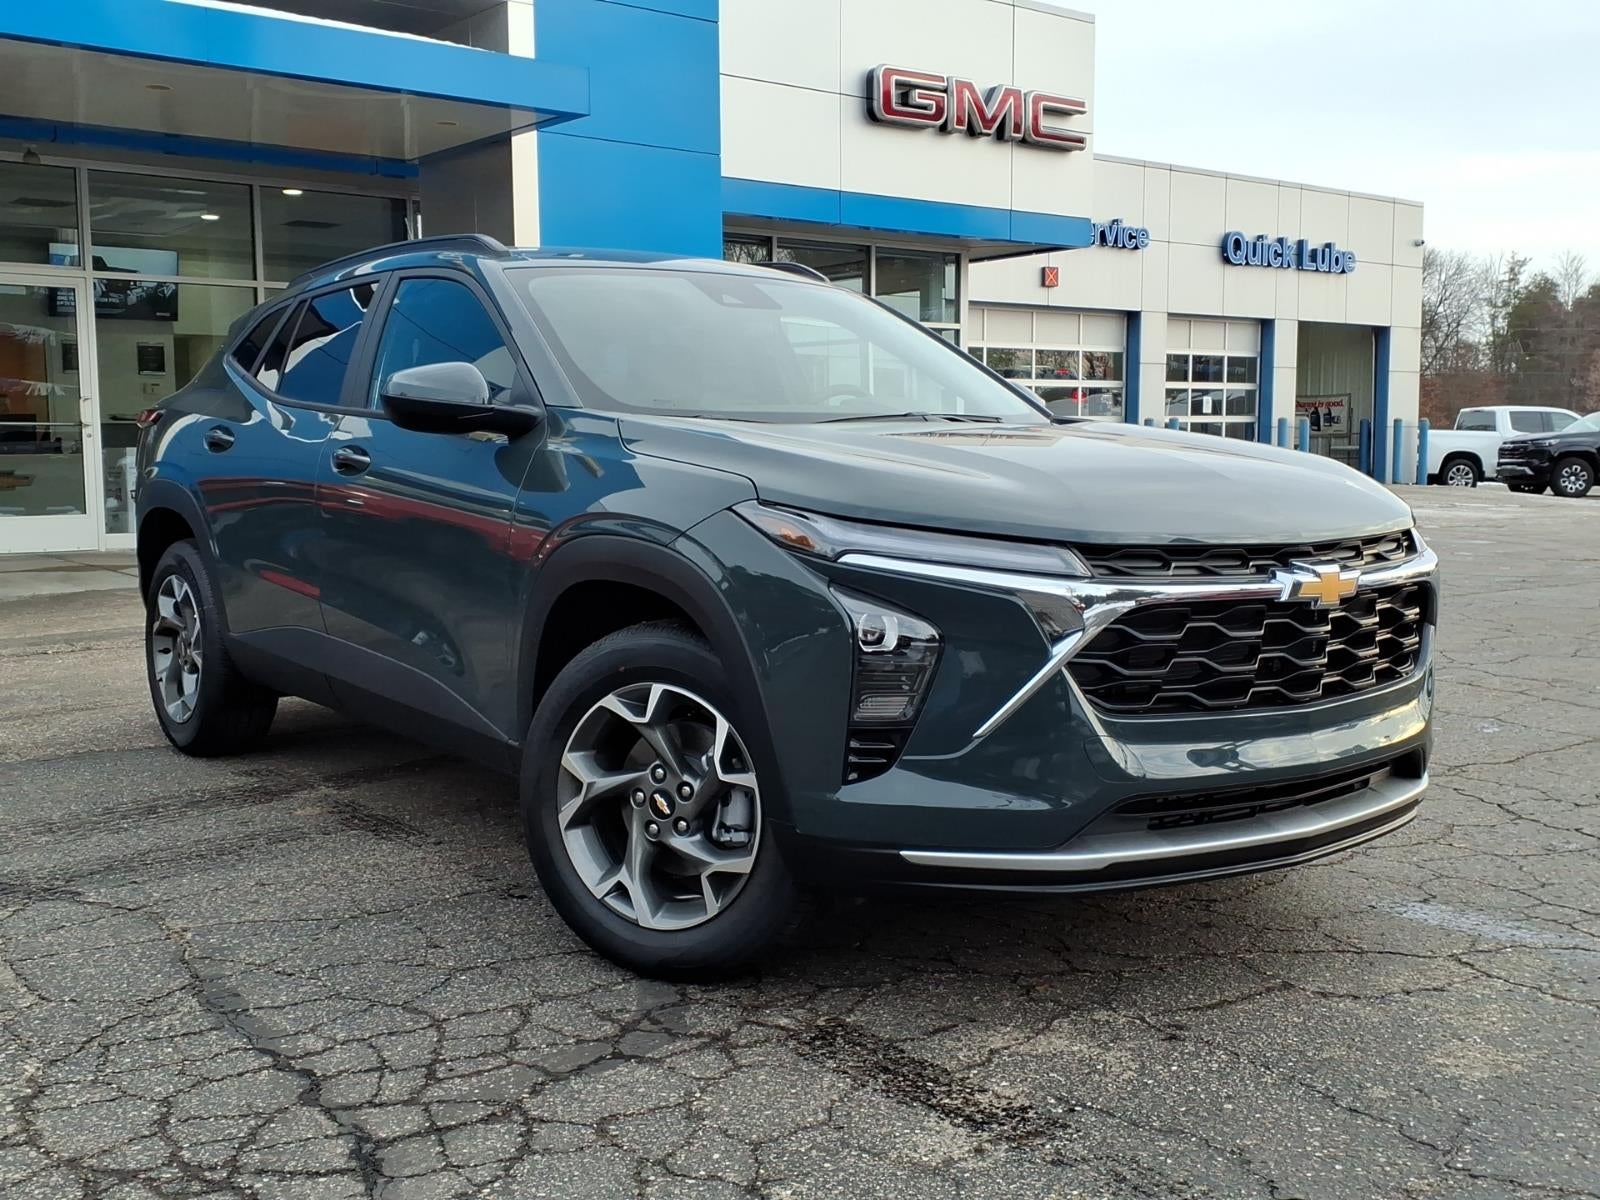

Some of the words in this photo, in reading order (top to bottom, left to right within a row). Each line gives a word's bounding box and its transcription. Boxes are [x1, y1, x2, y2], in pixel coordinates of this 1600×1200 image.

[869, 64, 1087, 151] GMC
[1223, 231, 1296, 268] Quick
[1297, 239, 1356, 273] Lube
